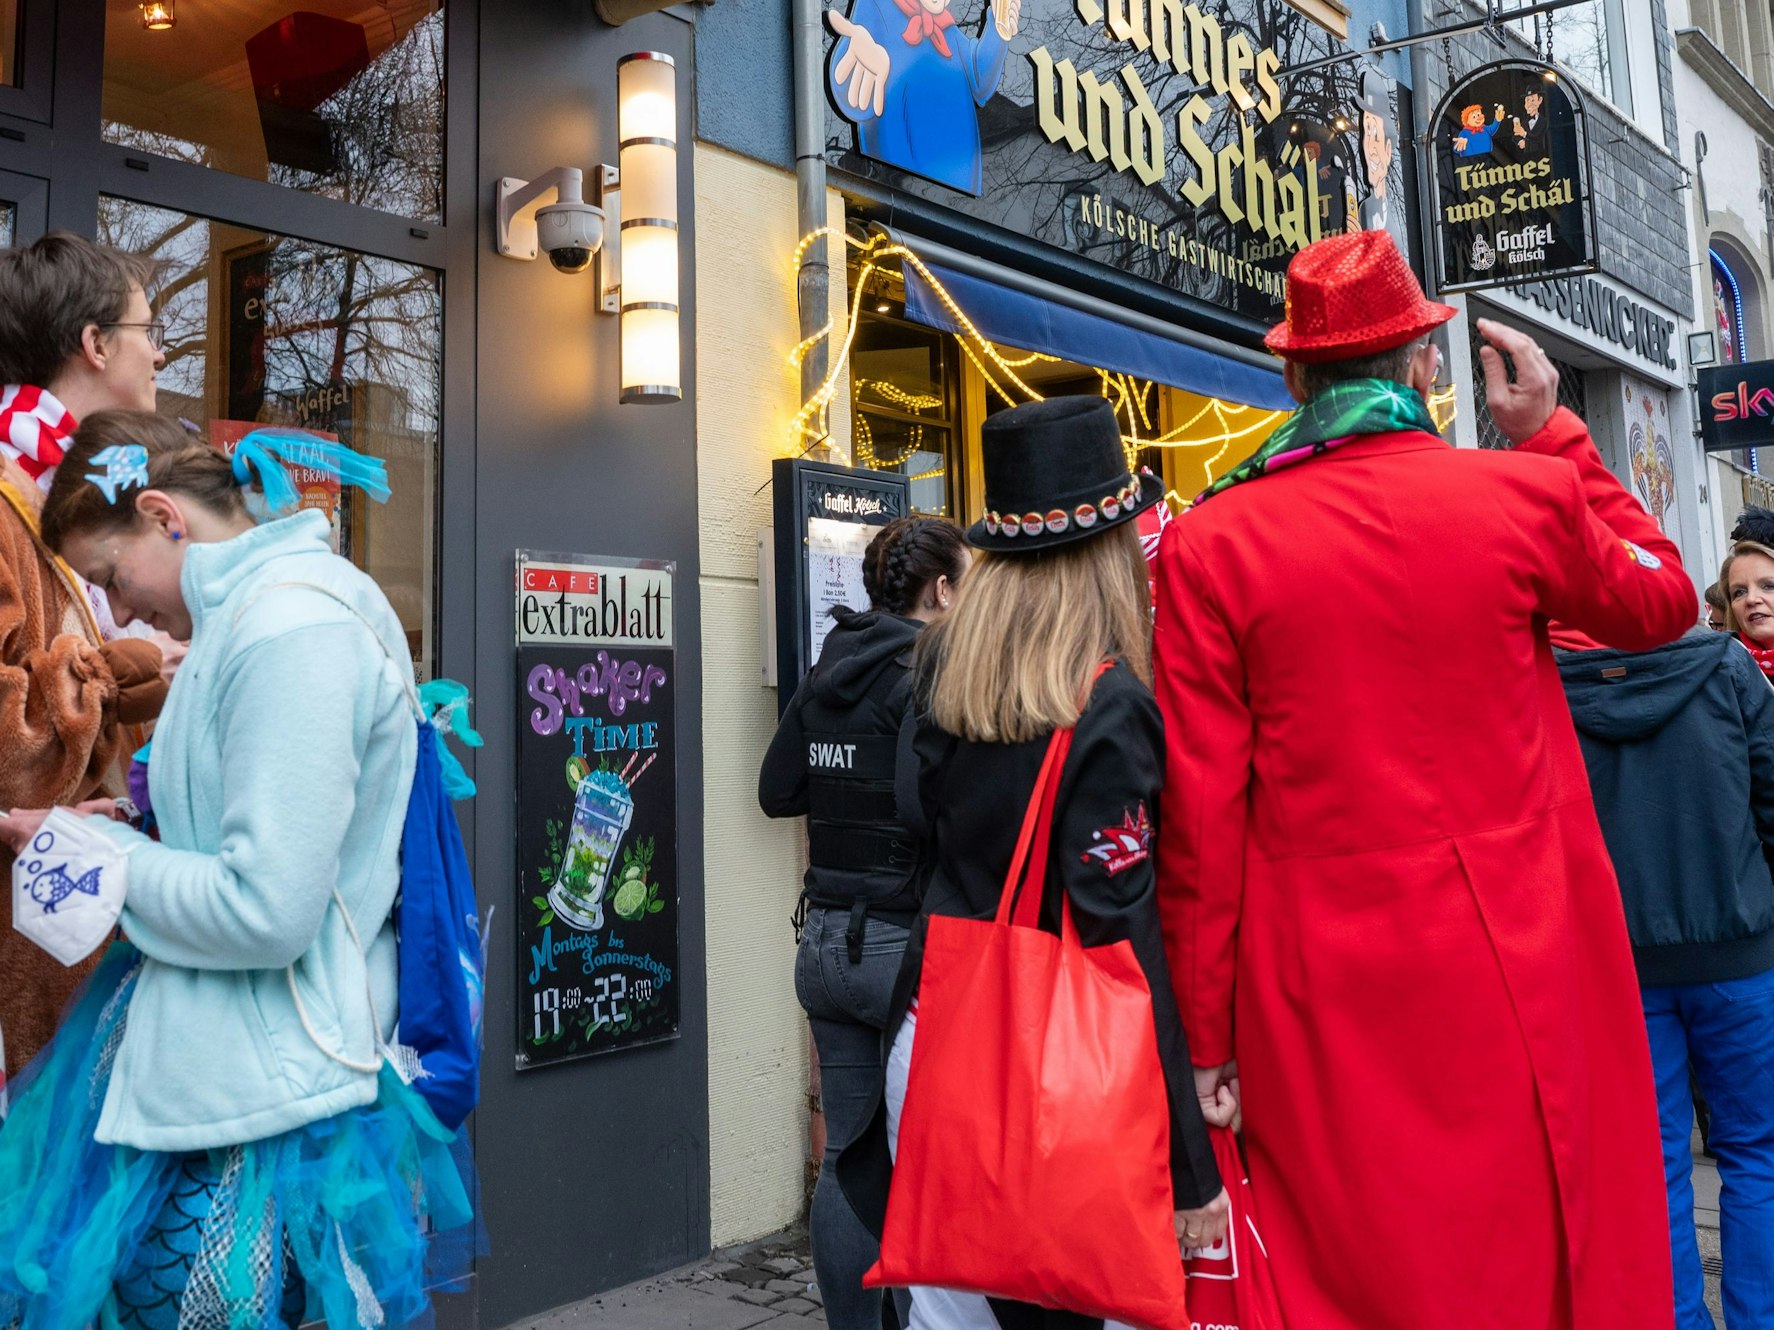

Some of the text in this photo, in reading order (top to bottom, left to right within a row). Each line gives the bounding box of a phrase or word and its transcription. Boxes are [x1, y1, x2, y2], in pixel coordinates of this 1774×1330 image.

[1074, 0, 1281, 124] nnes
[1029, 46, 1321, 251] und Schäl
[1454, 157, 1551, 192] Tünnes
[1081, 194, 1160, 250] KÖLSCHE
[1445, 177, 1574, 224] und Schäl
[1496, 222, 1556, 252] Gaffel
[825, 492, 853, 513] Gaffel
[523, 574, 671, 639] extrablatt
[527, 572, 595, 590] CAFE
[527, 650, 667, 735] Shaker
[809, 742, 857, 769] SWAT
[529, 926, 625, 985] Montags bis
